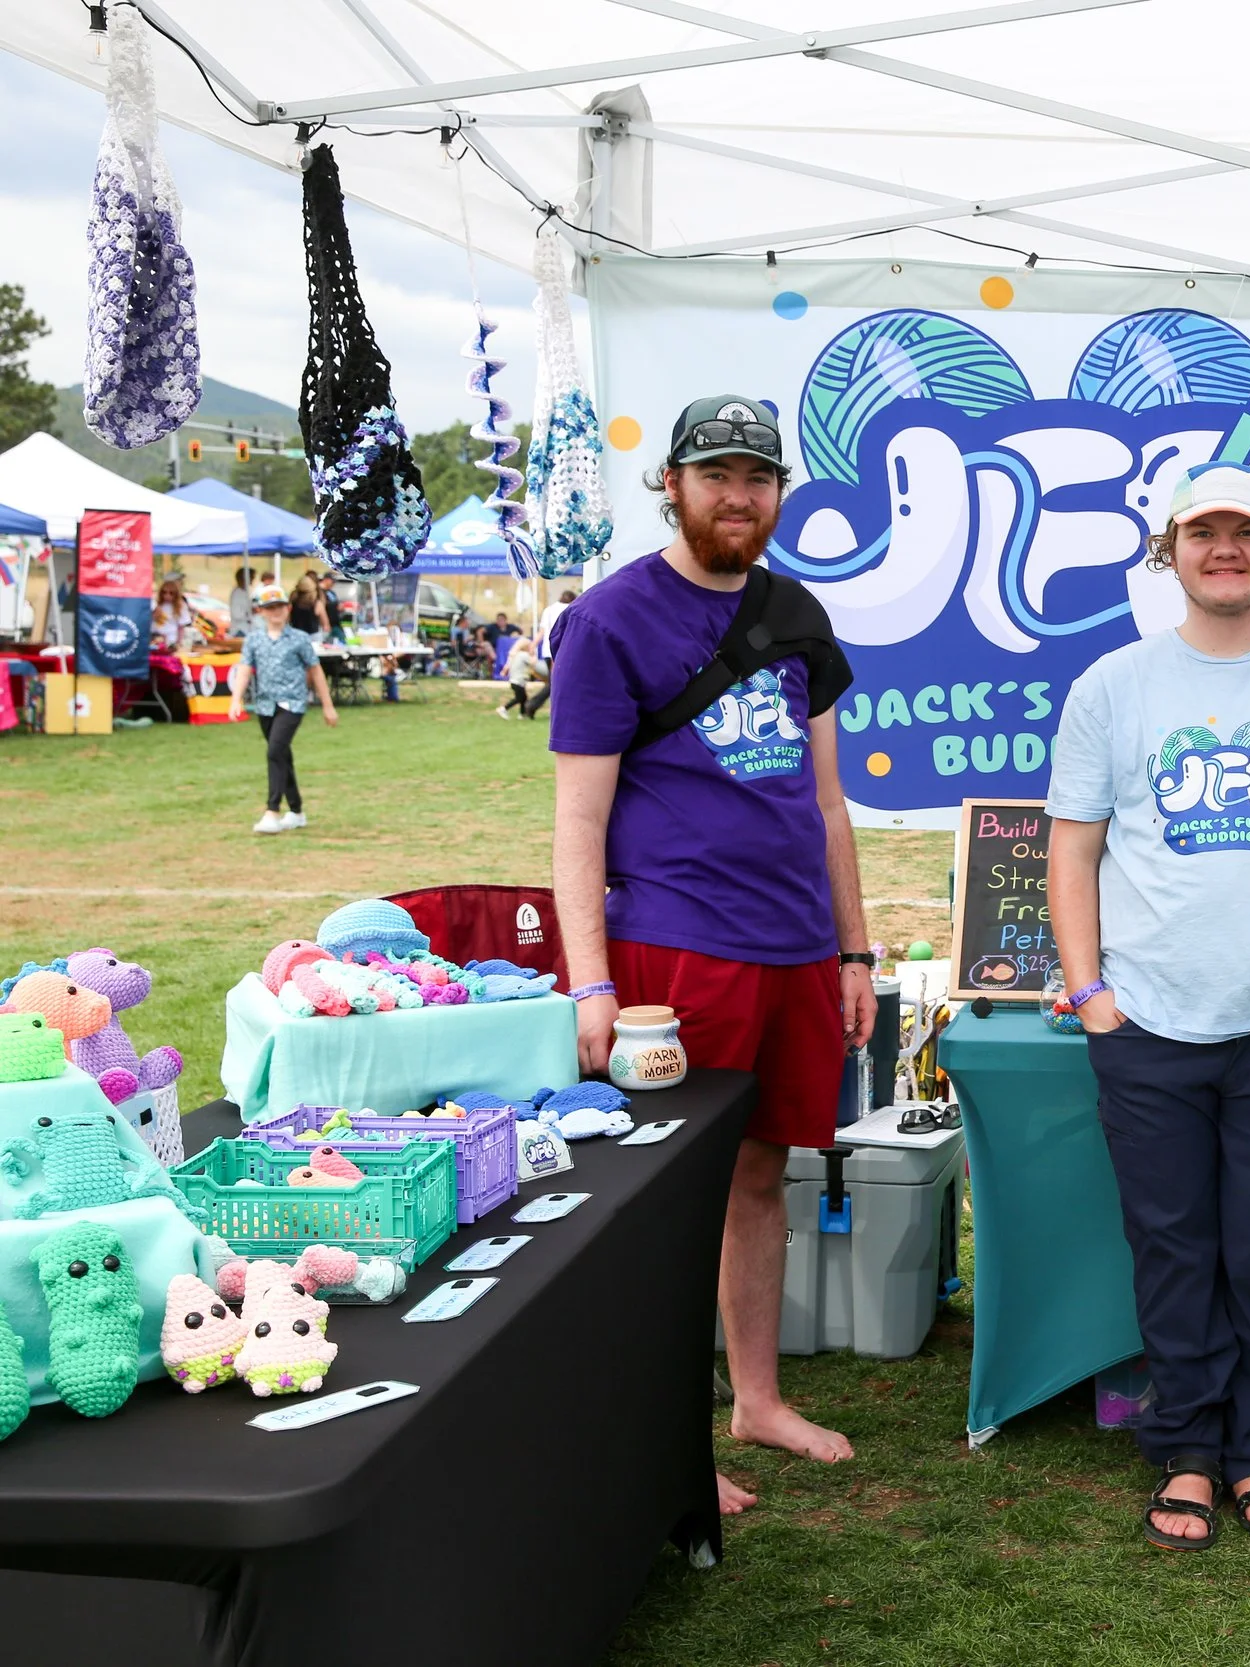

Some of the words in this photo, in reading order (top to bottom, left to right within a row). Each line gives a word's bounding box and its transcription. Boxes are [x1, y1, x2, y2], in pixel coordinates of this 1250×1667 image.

[840, 680, 1053, 733] JACK'S
[720, 746, 771, 766] JACK'S
[773, 745, 803, 758] FUZZY
[744, 758, 793, 773] BUDDIES
[977, 812, 1039, 839] Build
[1170, 817, 1230, 836] JACK'S
[517, 929, 543, 939] SIERRA
[518, 936, 544, 945] DESIGNS
[1016, 954, 1050, 976] $25
[641, 1048, 678, 1066] YARN
[644, 1060, 681, 1079] MONEY
[271, 1400, 338, 1423] Patrick
